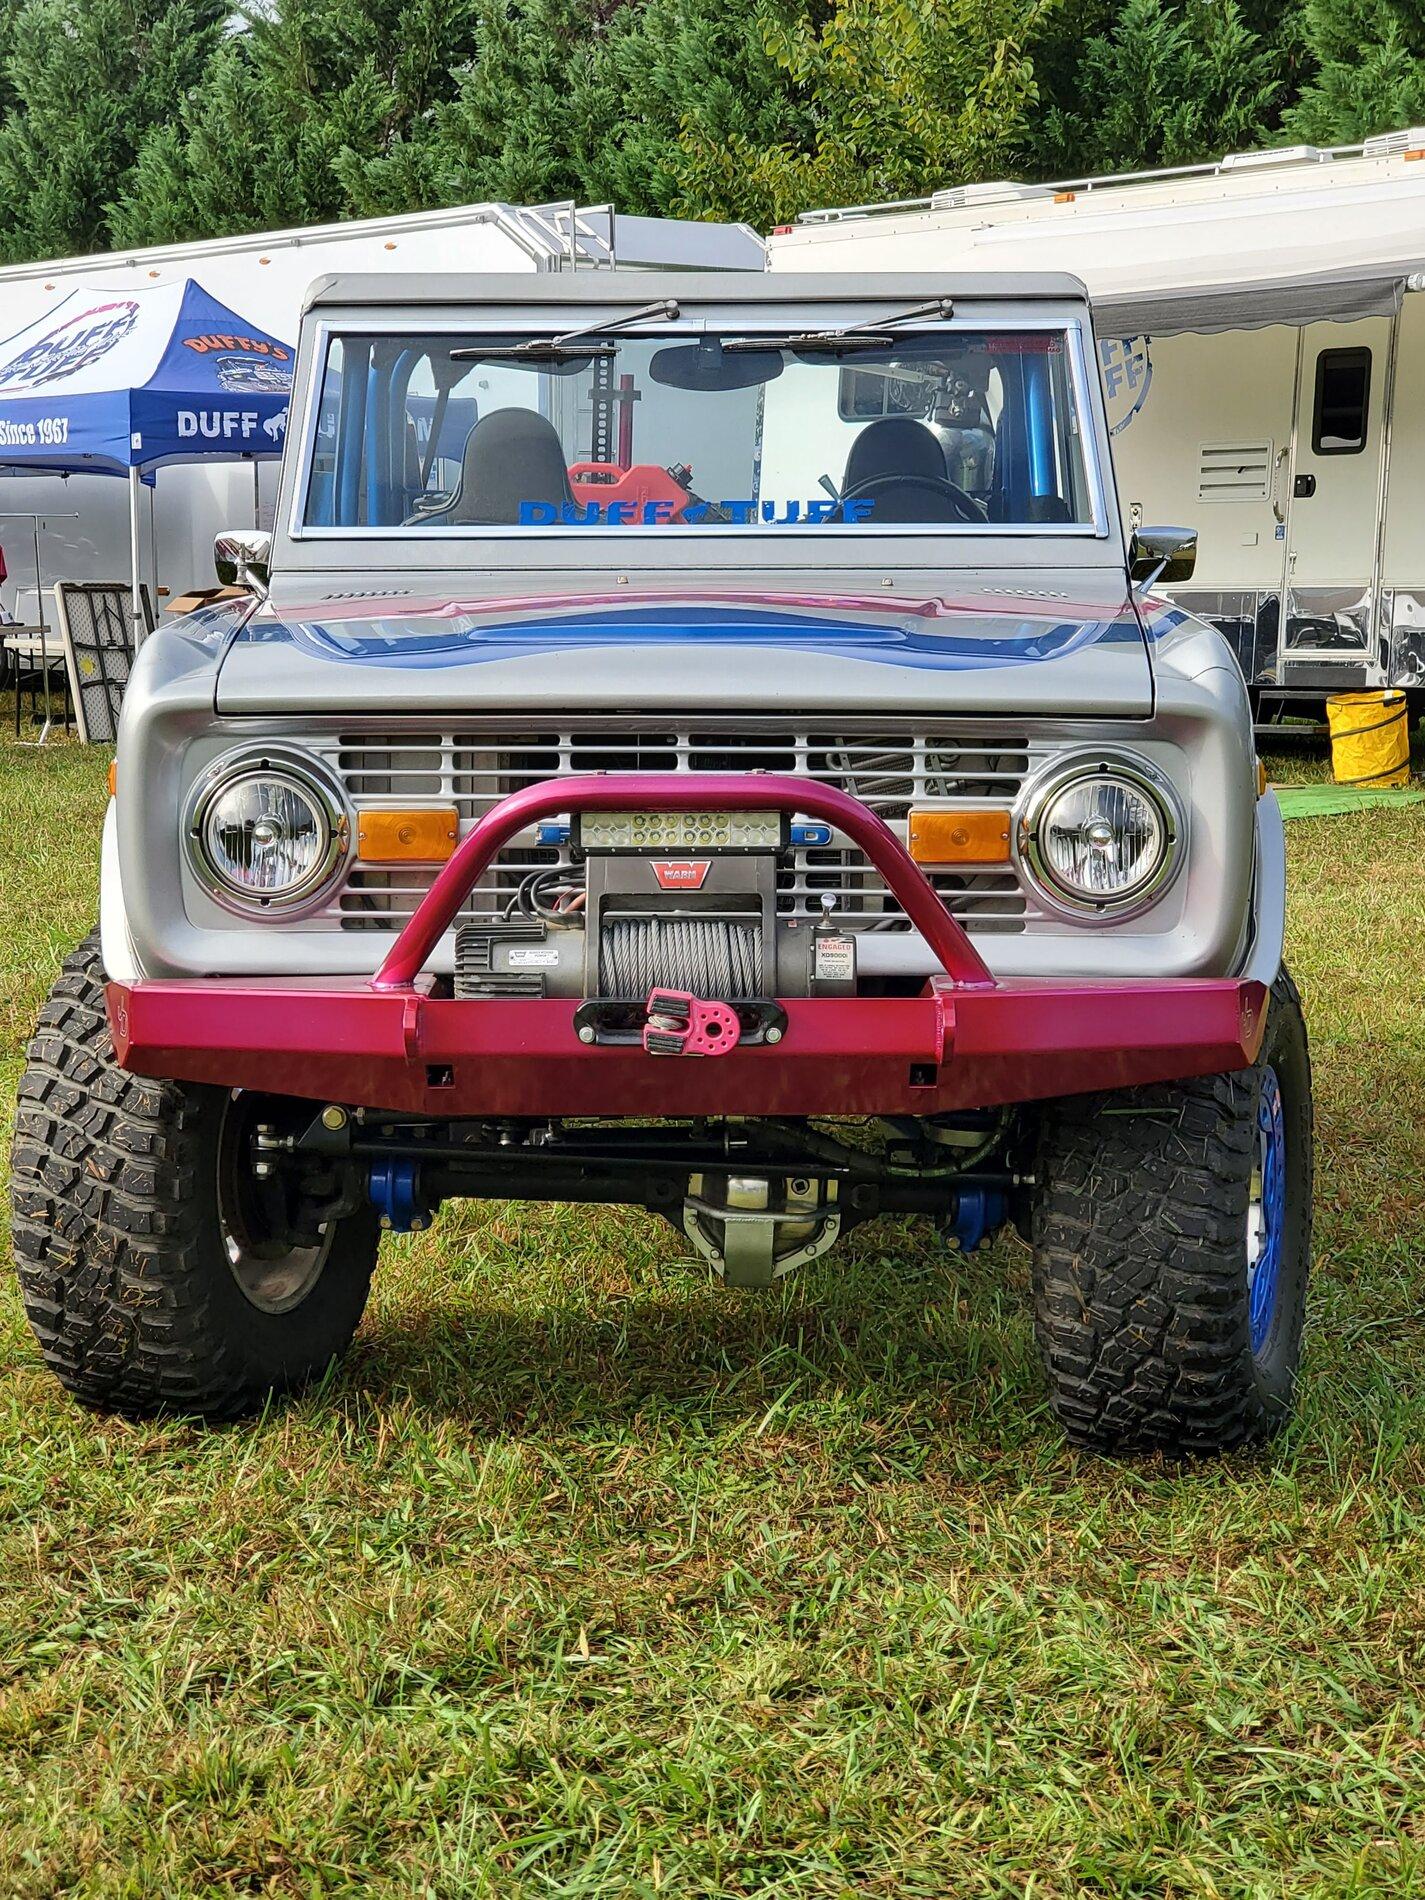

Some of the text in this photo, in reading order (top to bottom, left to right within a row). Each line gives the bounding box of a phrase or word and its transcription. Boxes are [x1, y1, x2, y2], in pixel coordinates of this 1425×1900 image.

[14, 314, 132, 363] DUFF
[182, 334, 289, 361] DUFFY'S
[0, 418, 69, 446] Since 1967
[177, 411, 258, 438] DUFF
[519, 500, 675, 525] DUFF
[720, 499, 875, 524] TUFF
[663, 870, 696, 880] WARN
[817, 943, 852, 951] ENGAGED
